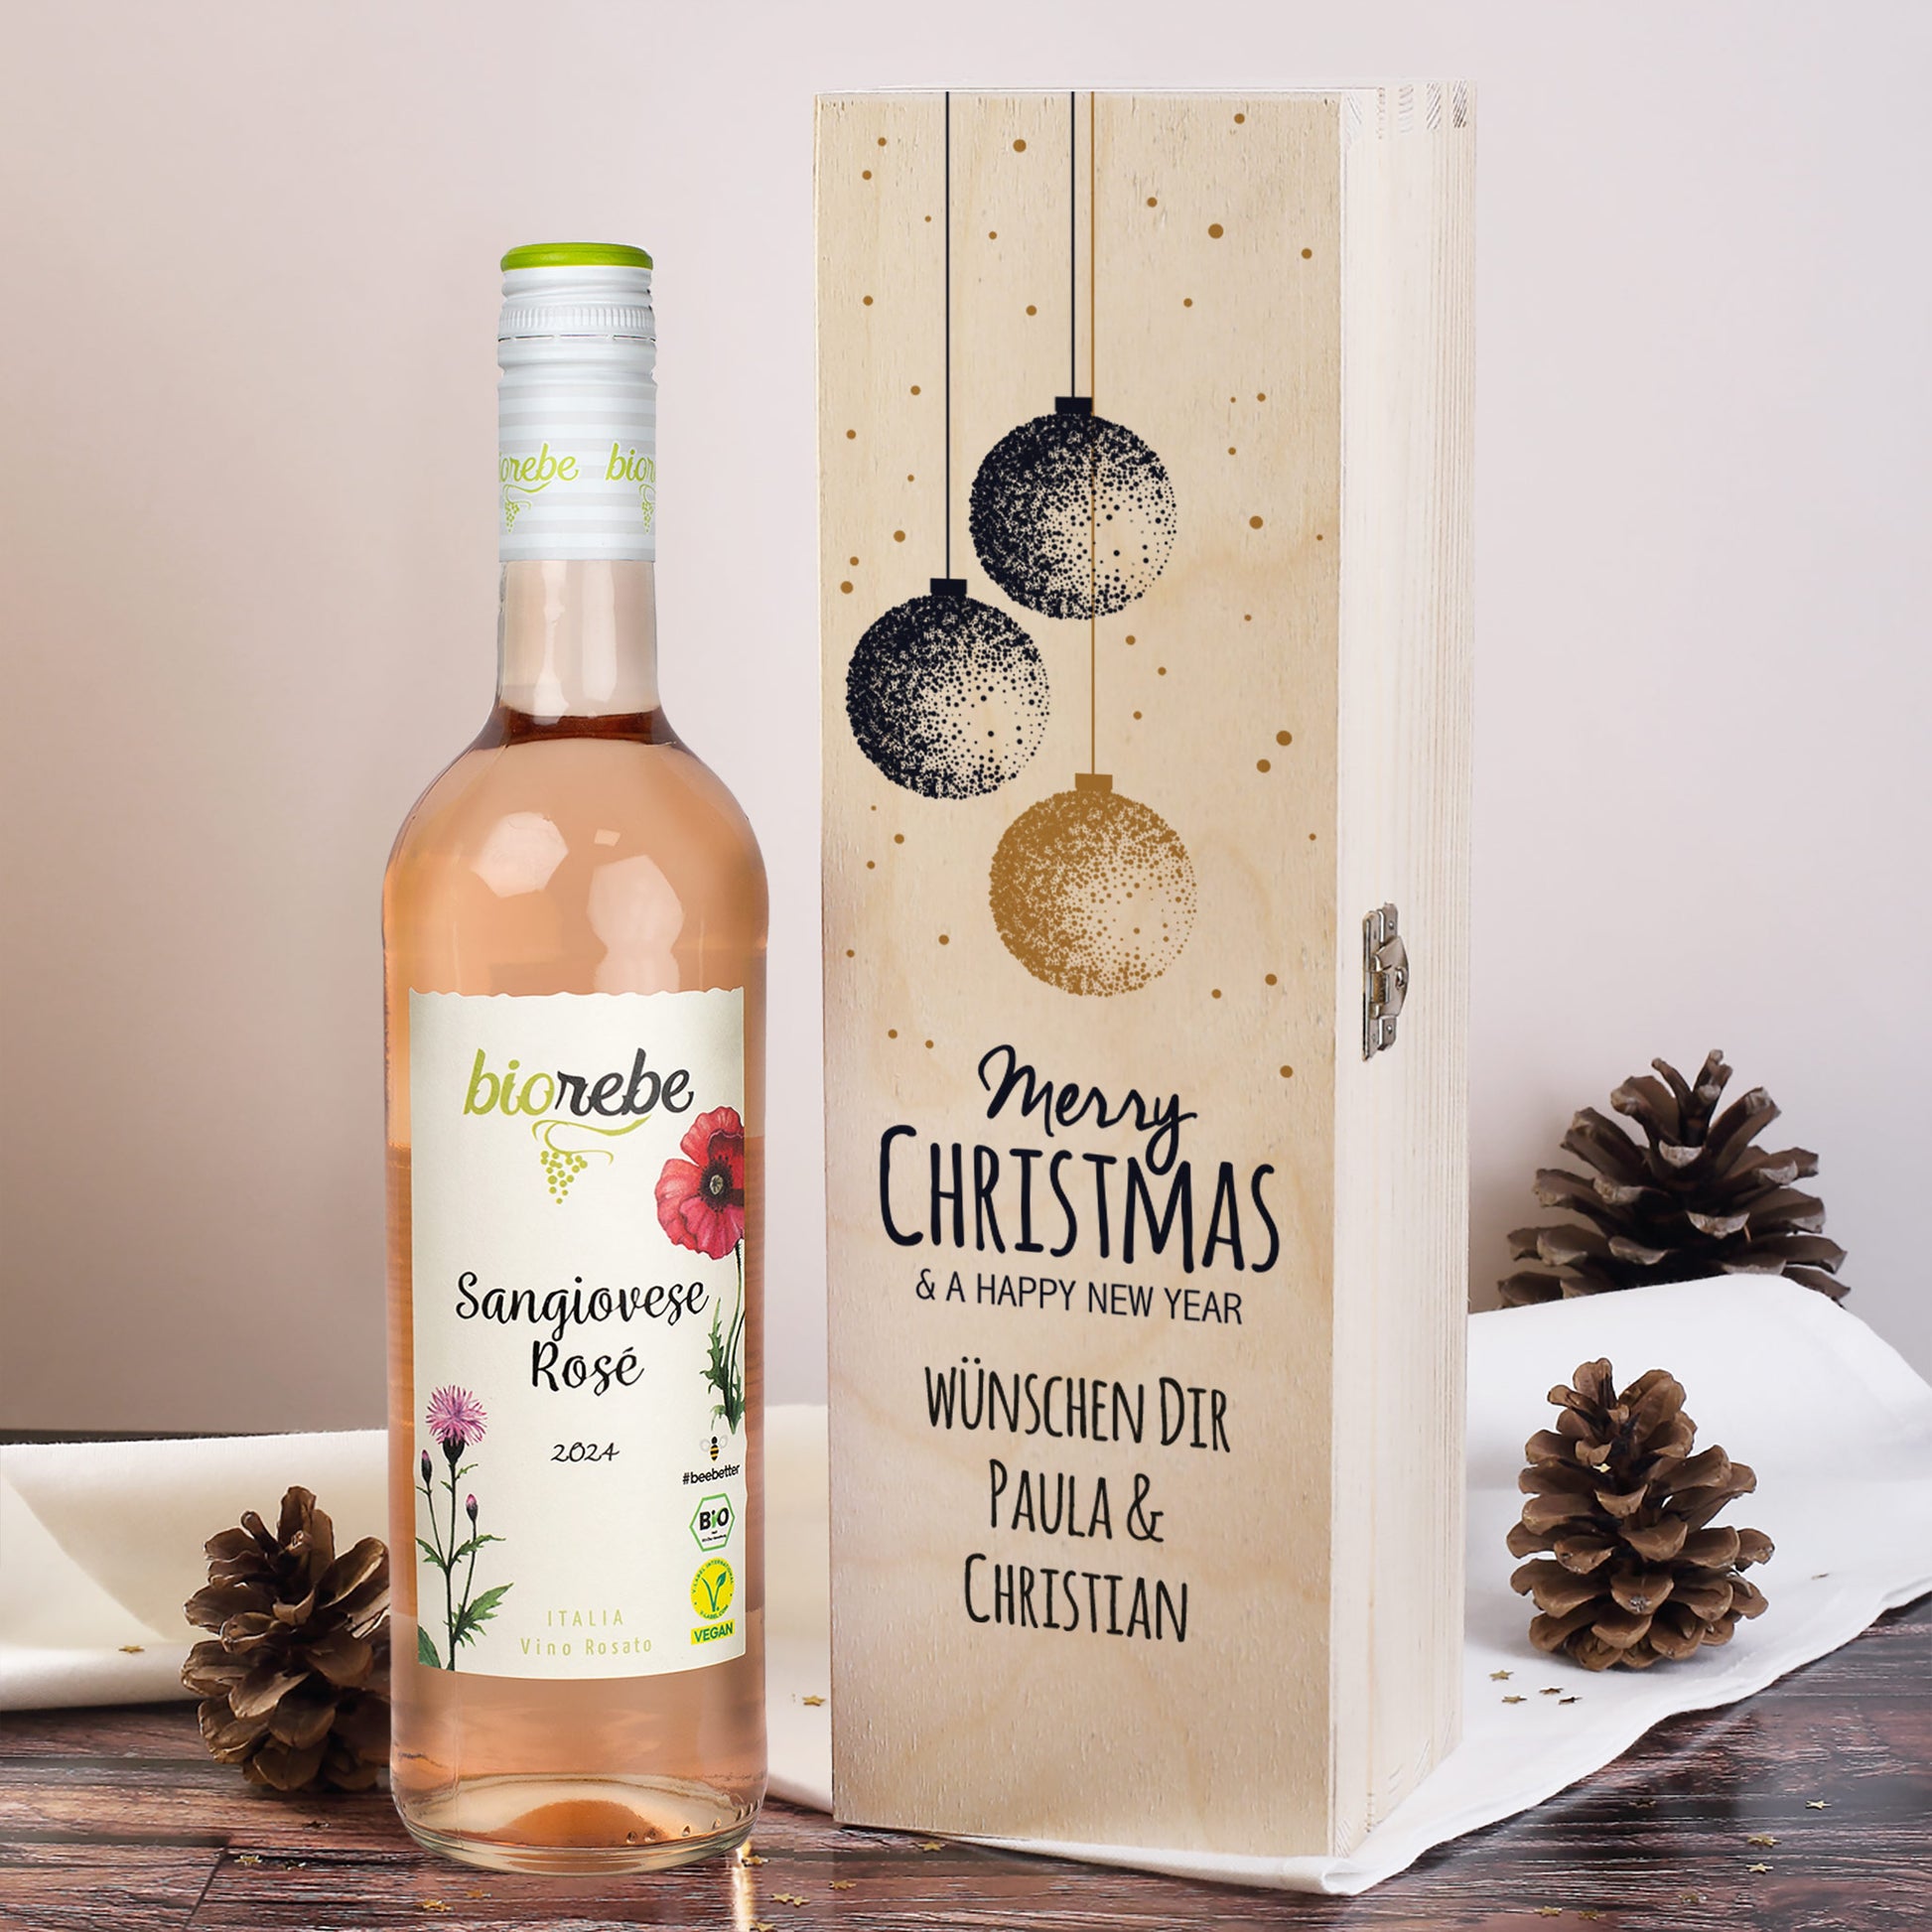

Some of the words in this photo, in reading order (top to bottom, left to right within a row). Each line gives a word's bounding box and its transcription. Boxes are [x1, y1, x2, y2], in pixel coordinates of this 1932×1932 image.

[463, 1047, 694, 1117] biorebe
[978, 1043, 1198, 1175] Merry
[880, 1125, 1281, 1274] CHRISTMAS
[455, 1272, 710, 1340] Sangiovese
[915, 1268, 936, 1301] &
[945, 1271, 966, 1303] A
[976, 1273, 1076, 1311] HAPPY
[1088, 1282, 1155, 1317] NEW
[1164, 1287, 1243, 1324] YEAR
[531, 1339, 645, 1397] Rosé
[551, 1442, 620, 1462] 2024
[682, 1464, 741, 1485] #beebetter
[1127, 1473, 1165, 1543] &
[520, 1638, 573, 1657] Vino
[585, 1636, 653, 1657] Rosato
[547, 1609, 624, 1627] ITALIA
[694, 1621, 734, 1642] VEGAN
